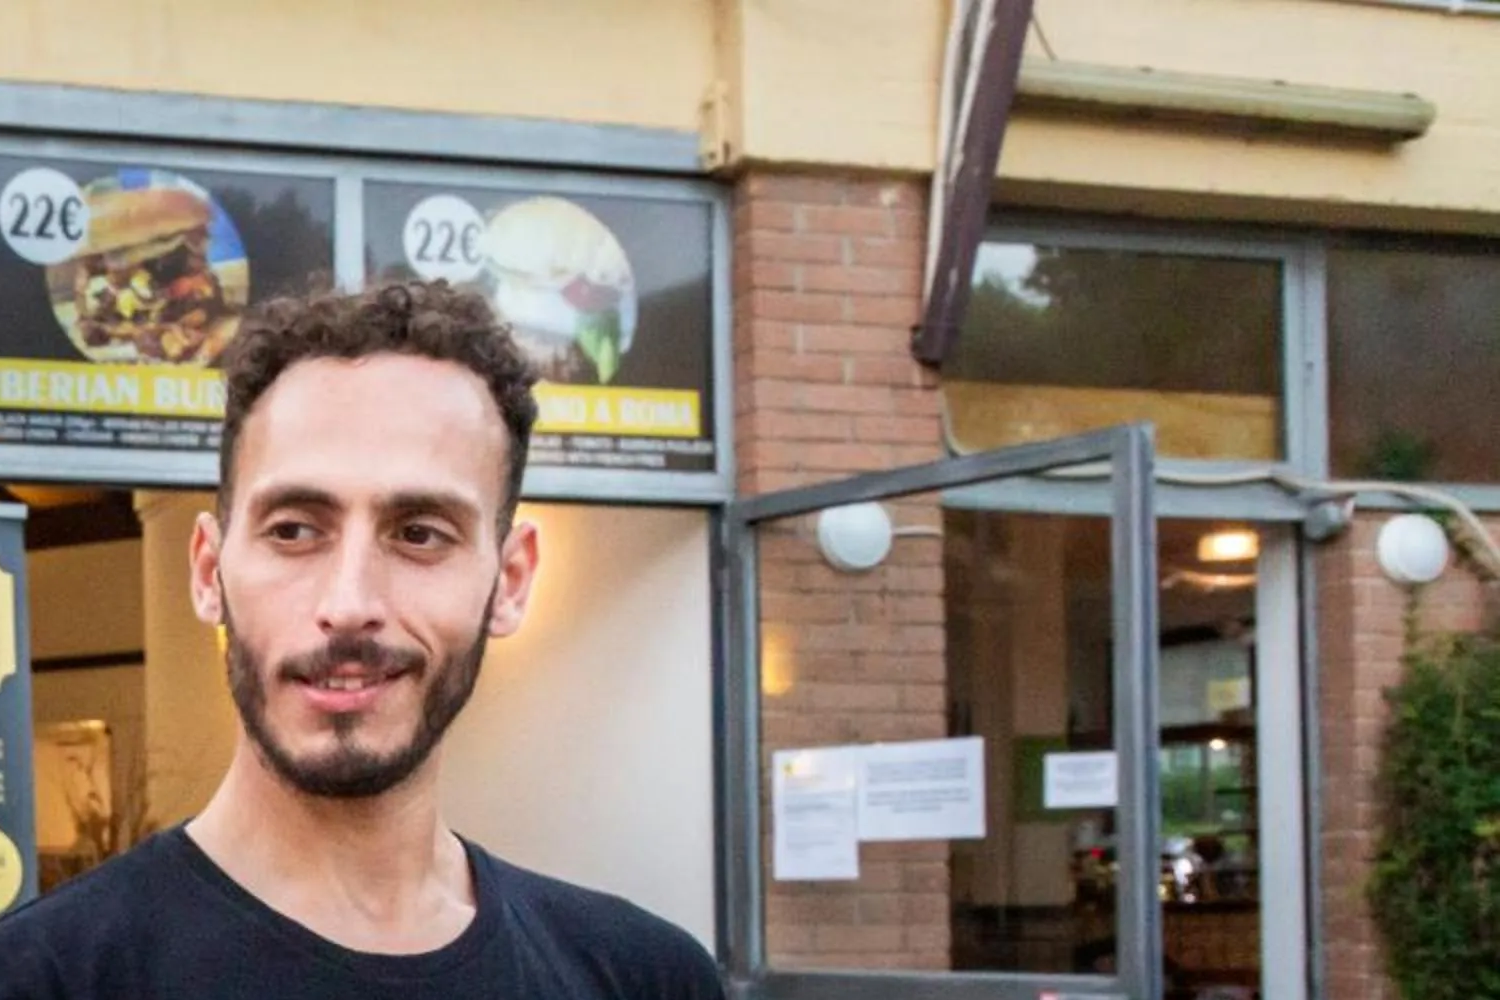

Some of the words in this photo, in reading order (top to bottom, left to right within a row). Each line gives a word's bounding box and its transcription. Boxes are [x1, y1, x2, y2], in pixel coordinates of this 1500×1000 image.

[8, 192, 84, 242] 22€
[413, 218, 482, 265] 22€
[154, 376, 227, 410] BUR
